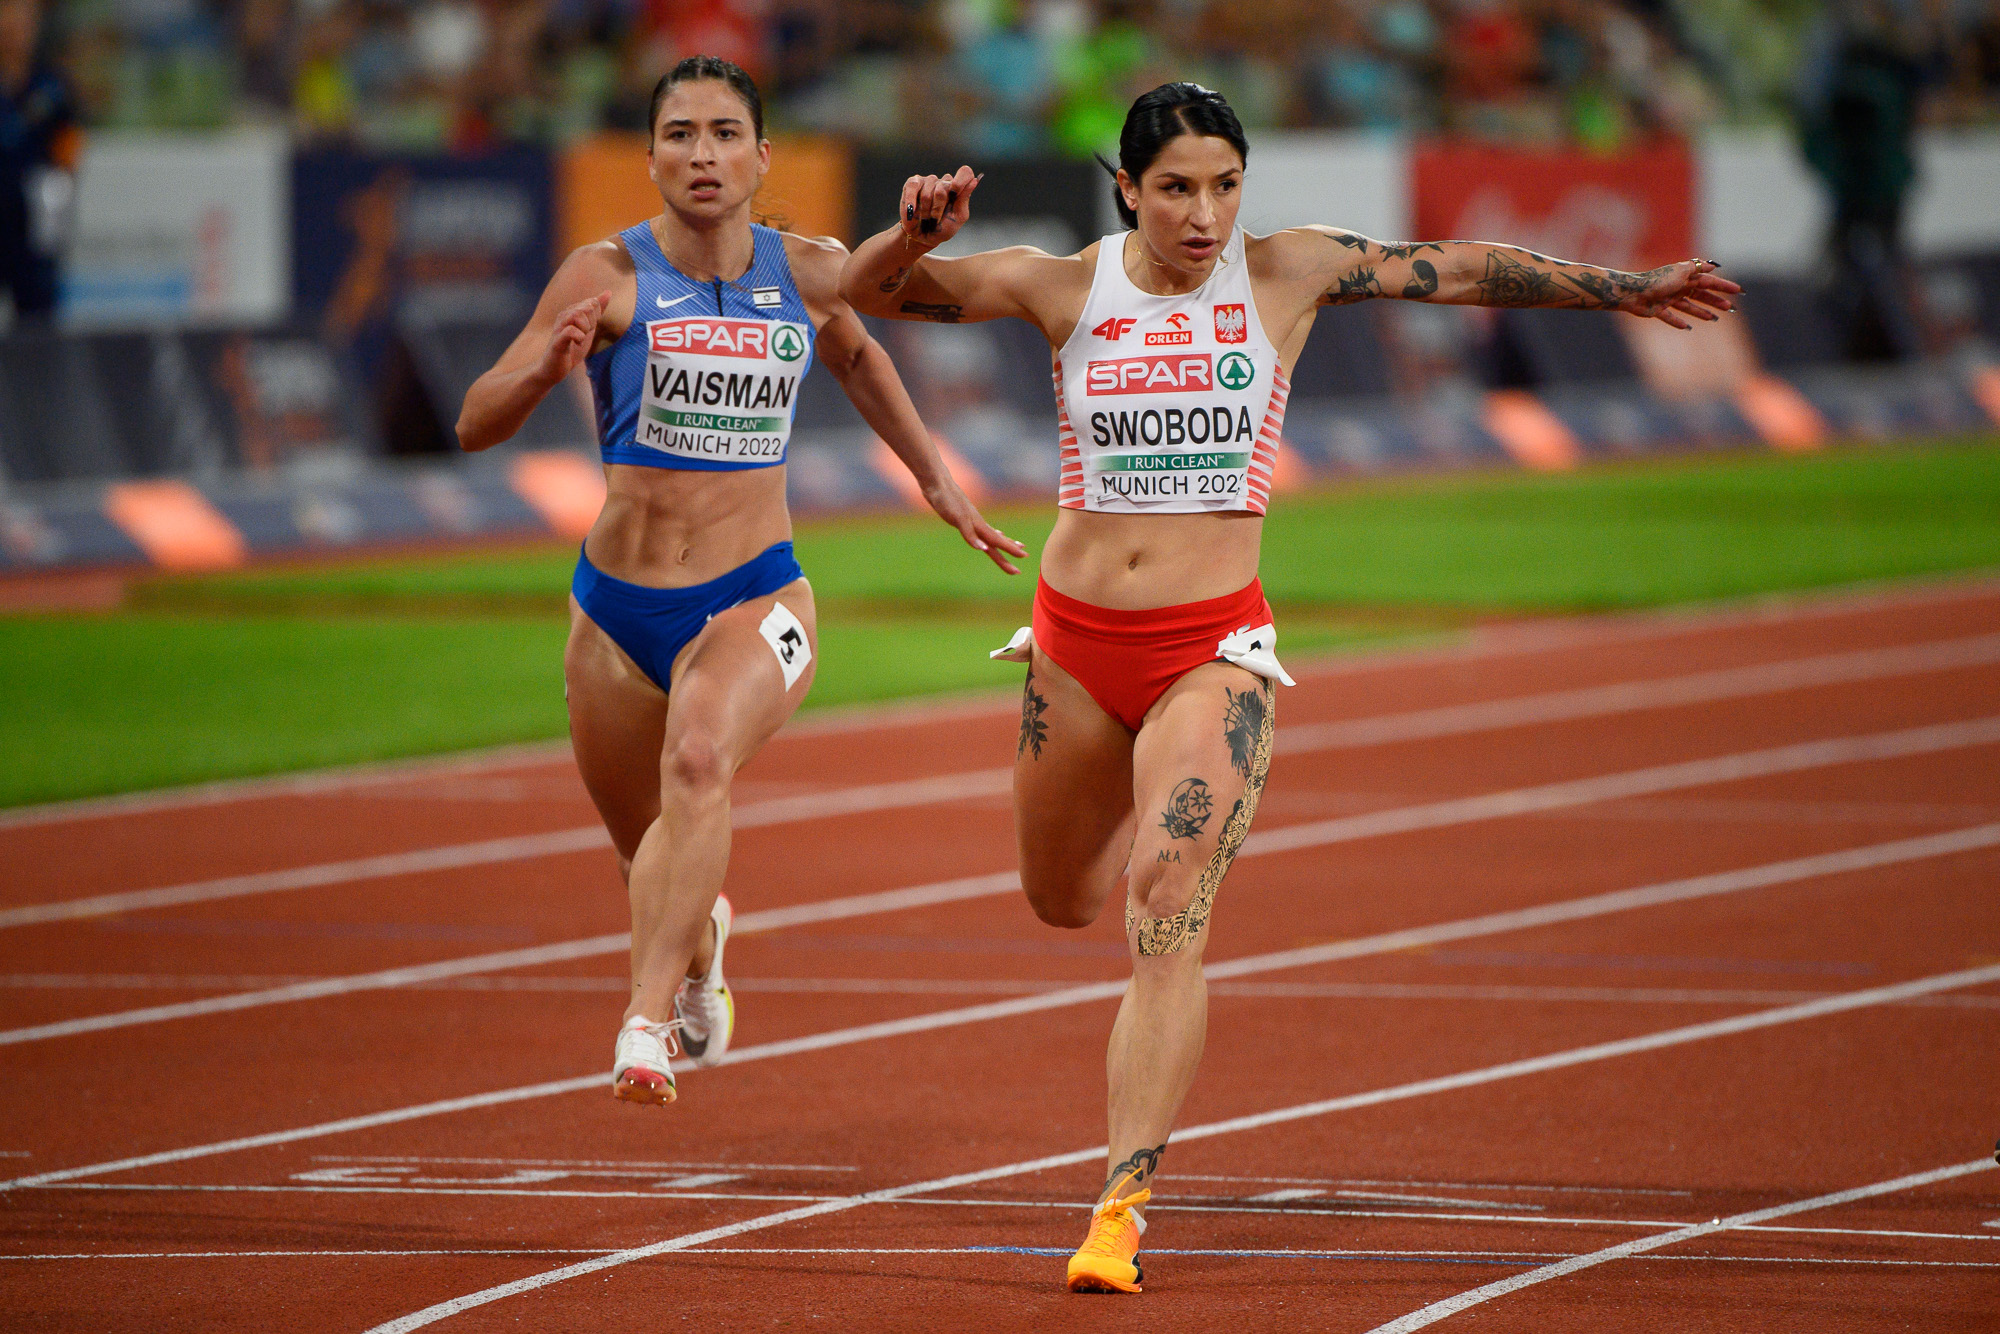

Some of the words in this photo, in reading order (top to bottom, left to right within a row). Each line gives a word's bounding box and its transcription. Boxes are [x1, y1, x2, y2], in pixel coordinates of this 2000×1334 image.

[655, 324, 765, 354] SPAR
[1092, 317, 1138, 341] 4F
[1147, 332, 1190, 344] ORLEN
[651, 363, 796, 408] VAISMAN
[1090, 359, 1210, 390] SPAR
[676, 413, 682, 425] I
[683, 415, 714, 428] RUN
[1091, 405, 1253, 446] SWOBODA
[646, 423, 731, 454] MUNICH
[738, 437, 782, 456] 2022
[1127, 457, 1132, 469] I
[1135, 456, 1167, 469] RUN
[1101, 475, 1189, 496] MUNICH
[778, 625, 802, 665] 5
